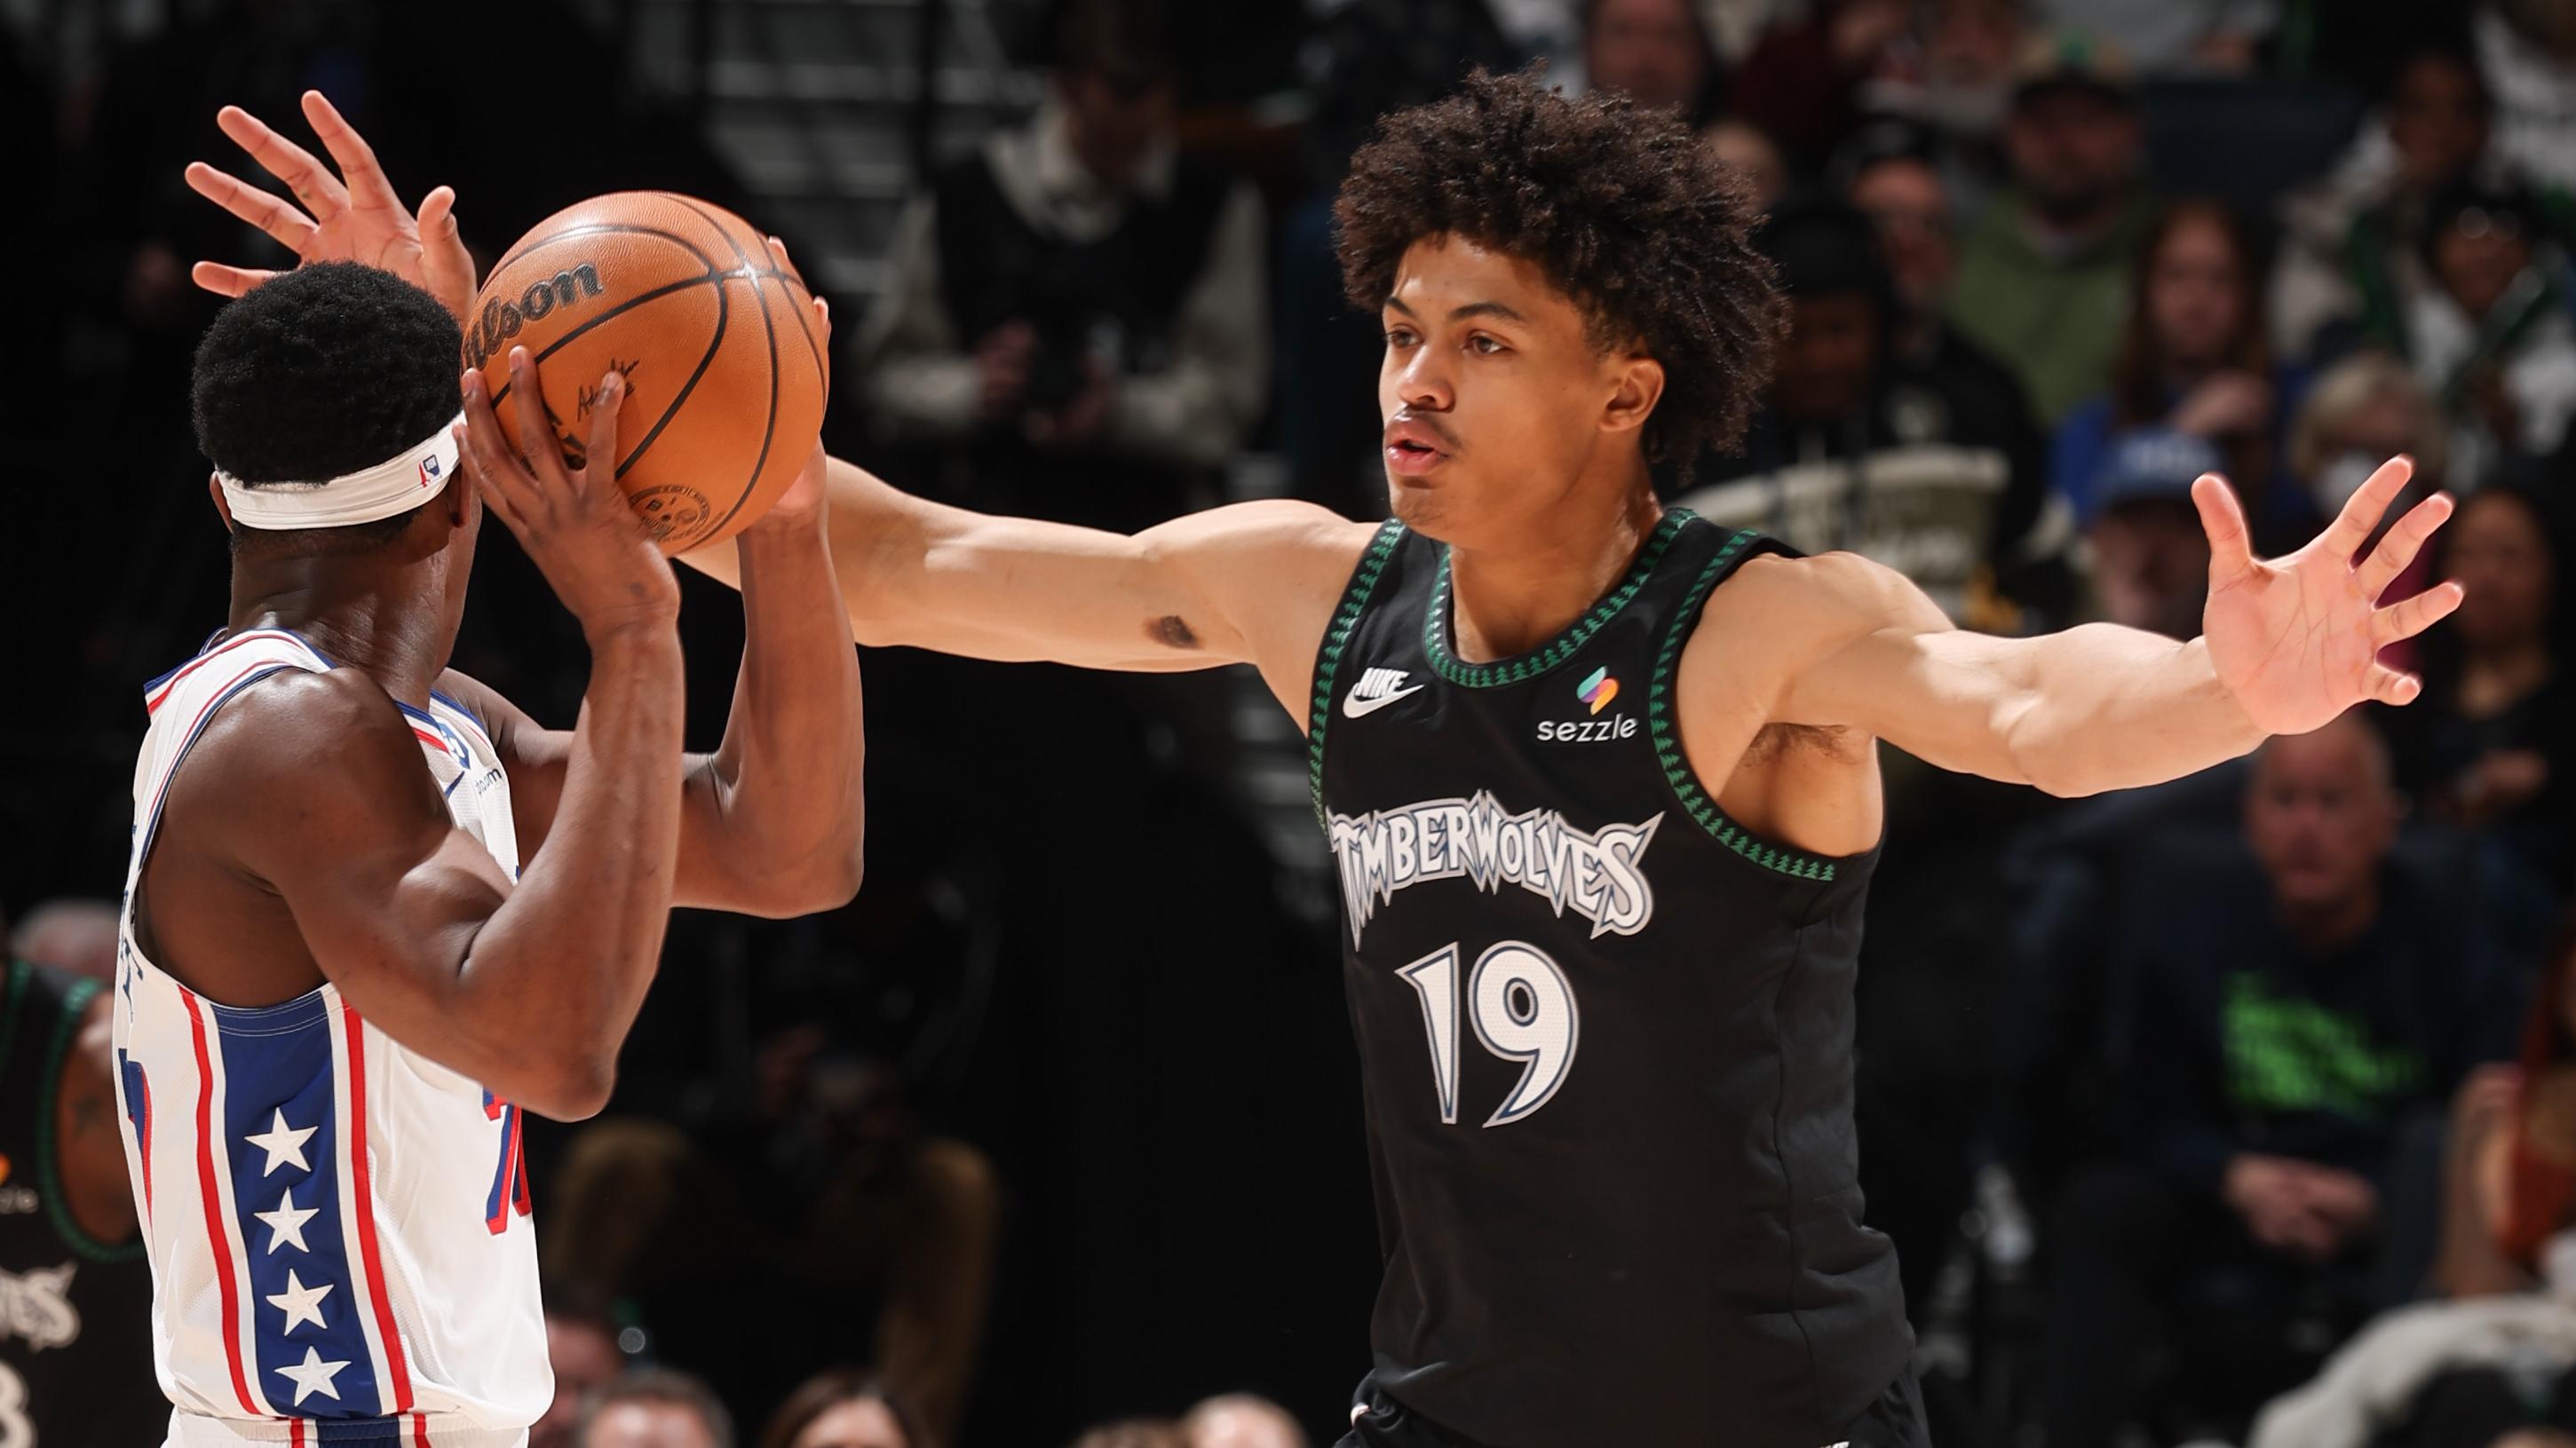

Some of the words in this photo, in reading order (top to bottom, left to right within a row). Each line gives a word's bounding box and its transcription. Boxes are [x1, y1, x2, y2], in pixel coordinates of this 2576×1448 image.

[464, 263, 605, 371] ilson
[1354, 667, 1410, 699] NIKE
[1536, 713, 1638, 742] sezzle
[1327, 788, 1666, 952] TIMBERWOLVES
[1394, 939, 1580, 1128] 19
